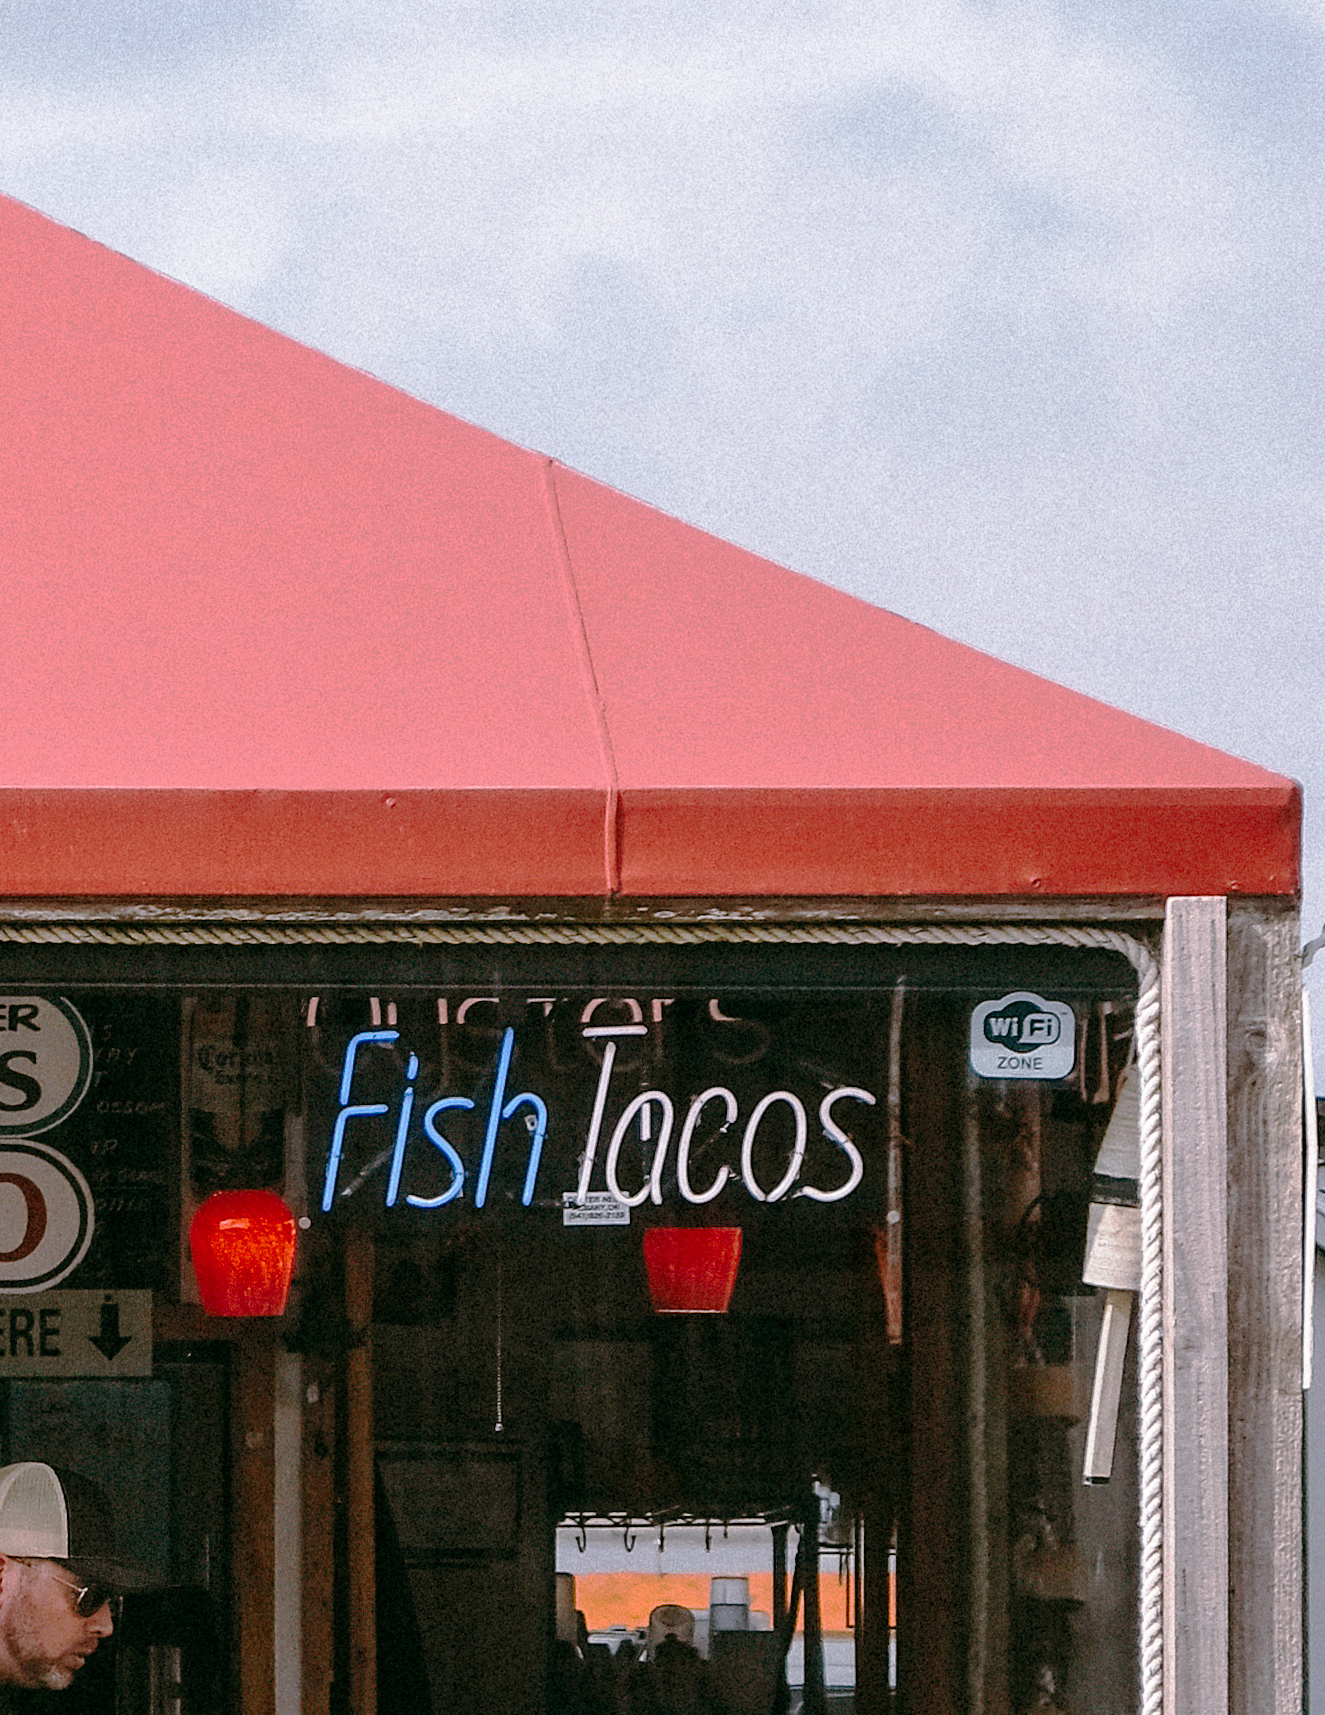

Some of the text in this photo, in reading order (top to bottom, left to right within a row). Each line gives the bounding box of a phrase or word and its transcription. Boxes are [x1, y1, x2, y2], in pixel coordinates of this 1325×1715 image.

[997, 1056, 1043, 1070] ZONE
[321, 1026, 877, 1212] Fish Tacos
